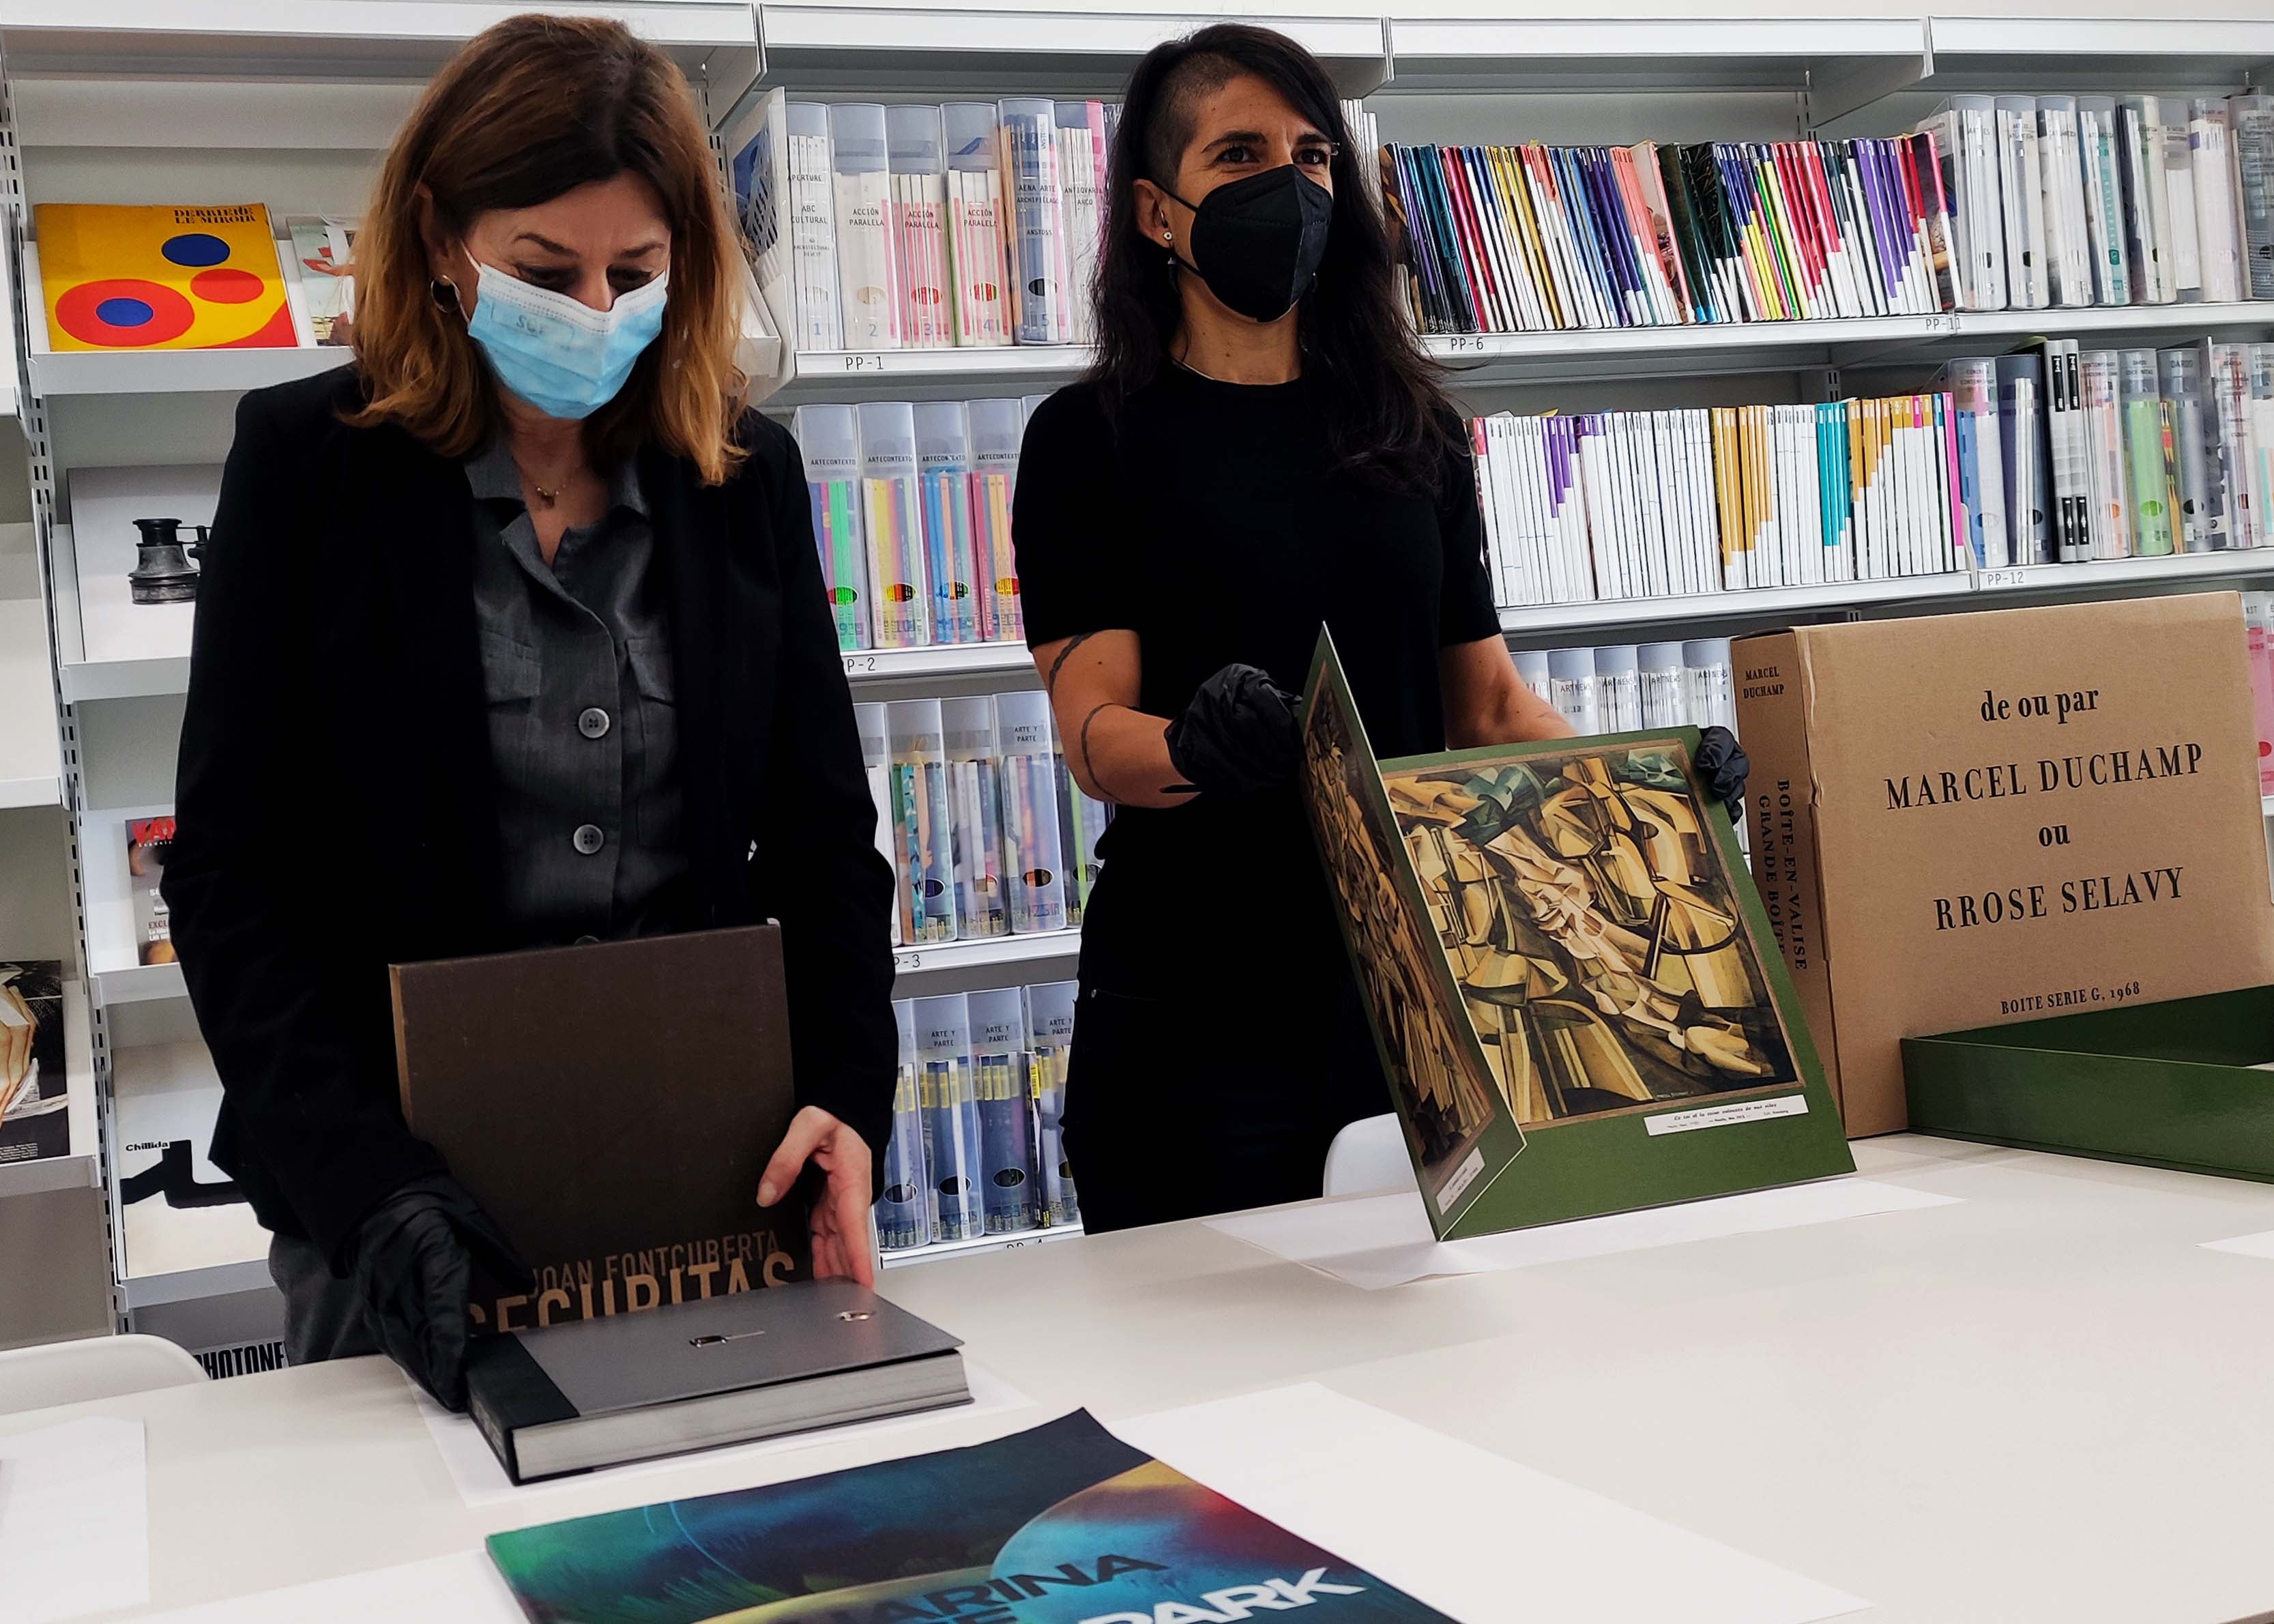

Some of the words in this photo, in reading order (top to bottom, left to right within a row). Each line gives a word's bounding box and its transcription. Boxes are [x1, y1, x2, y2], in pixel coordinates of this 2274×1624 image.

[787, 174, 823, 182] APERTURE
[802, 205, 816, 213] ABC
[853, 207, 879, 216] ACCIÓN
[908, 209, 934, 218] ACCIÓN
[967, 208, 993, 217] ACCIÓN
[201, 215, 256, 224] MIROIR
[791, 216, 828, 224] CULTURAL
[905, 220, 939, 229] PARALELA
[963, 218, 998, 227] PARALELA
[983, 319, 992, 332] 4
[1925, 317, 1962, 331] PP-11
[813, 323, 821, 336] 1
[869, 323, 878, 338] 2
[924, 323, 933, 336] 3
[1451, 336, 1484, 351] PP-6
[845, 356, 884, 371] PP-1
[811, 458, 856, 466] ARTECONTEXTO
[868, 454, 913, 463] ARTECONTEXTO
[922, 453, 966, 463] ARTECONTEXTO
[1987, 572, 2024, 585] PP-12
[1745, 666, 1780, 681] MARCEL
[1650, 675, 1682, 685] ARTNEWS
[1743, 684, 1785, 699] DUCHAMP
[1981, 689, 2011, 722] de
[2018, 695, 2050, 719] ou
[2055, 688, 2099, 725] par
[1015, 725, 1031, 734] ARTE
[1884, 763, 2027, 810] MARCEL
[2037, 742, 2203, 792] DUCHAMP
[1759, 795, 1777, 883] GRANDE
[2038, 824, 2071, 847] ou
[1934, 885, 2047, 931] RROSE
[2061, 867, 2184, 914] SELAVY
[148, 920, 168, 929] EXCL
[893, 954, 921, 968] P-3
[2000, 996, 2044, 1015] BOITE
[2047, 989, 2088, 1008] SERIE
[2091, 987, 2106, 1002] G,
[2110, 981, 2141, 1002] 1968
[1049, 1019, 1065, 1027] ARTE
[931, 1030, 948, 1039] ARTE
[950, 1029, 955, 1037] Y
[986, 1026, 1003, 1034] ARTE
[934, 1039, 954, 1047] PARTE
[989, 1034, 1009, 1043] PARTE
[126, 1141, 169, 1152] Chillida
[529, 1259, 594, 1297] JOAN
[605, 1230, 781, 1277] FONTCUBERTA
[469, 1251, 795, 1333] ECURITAS
